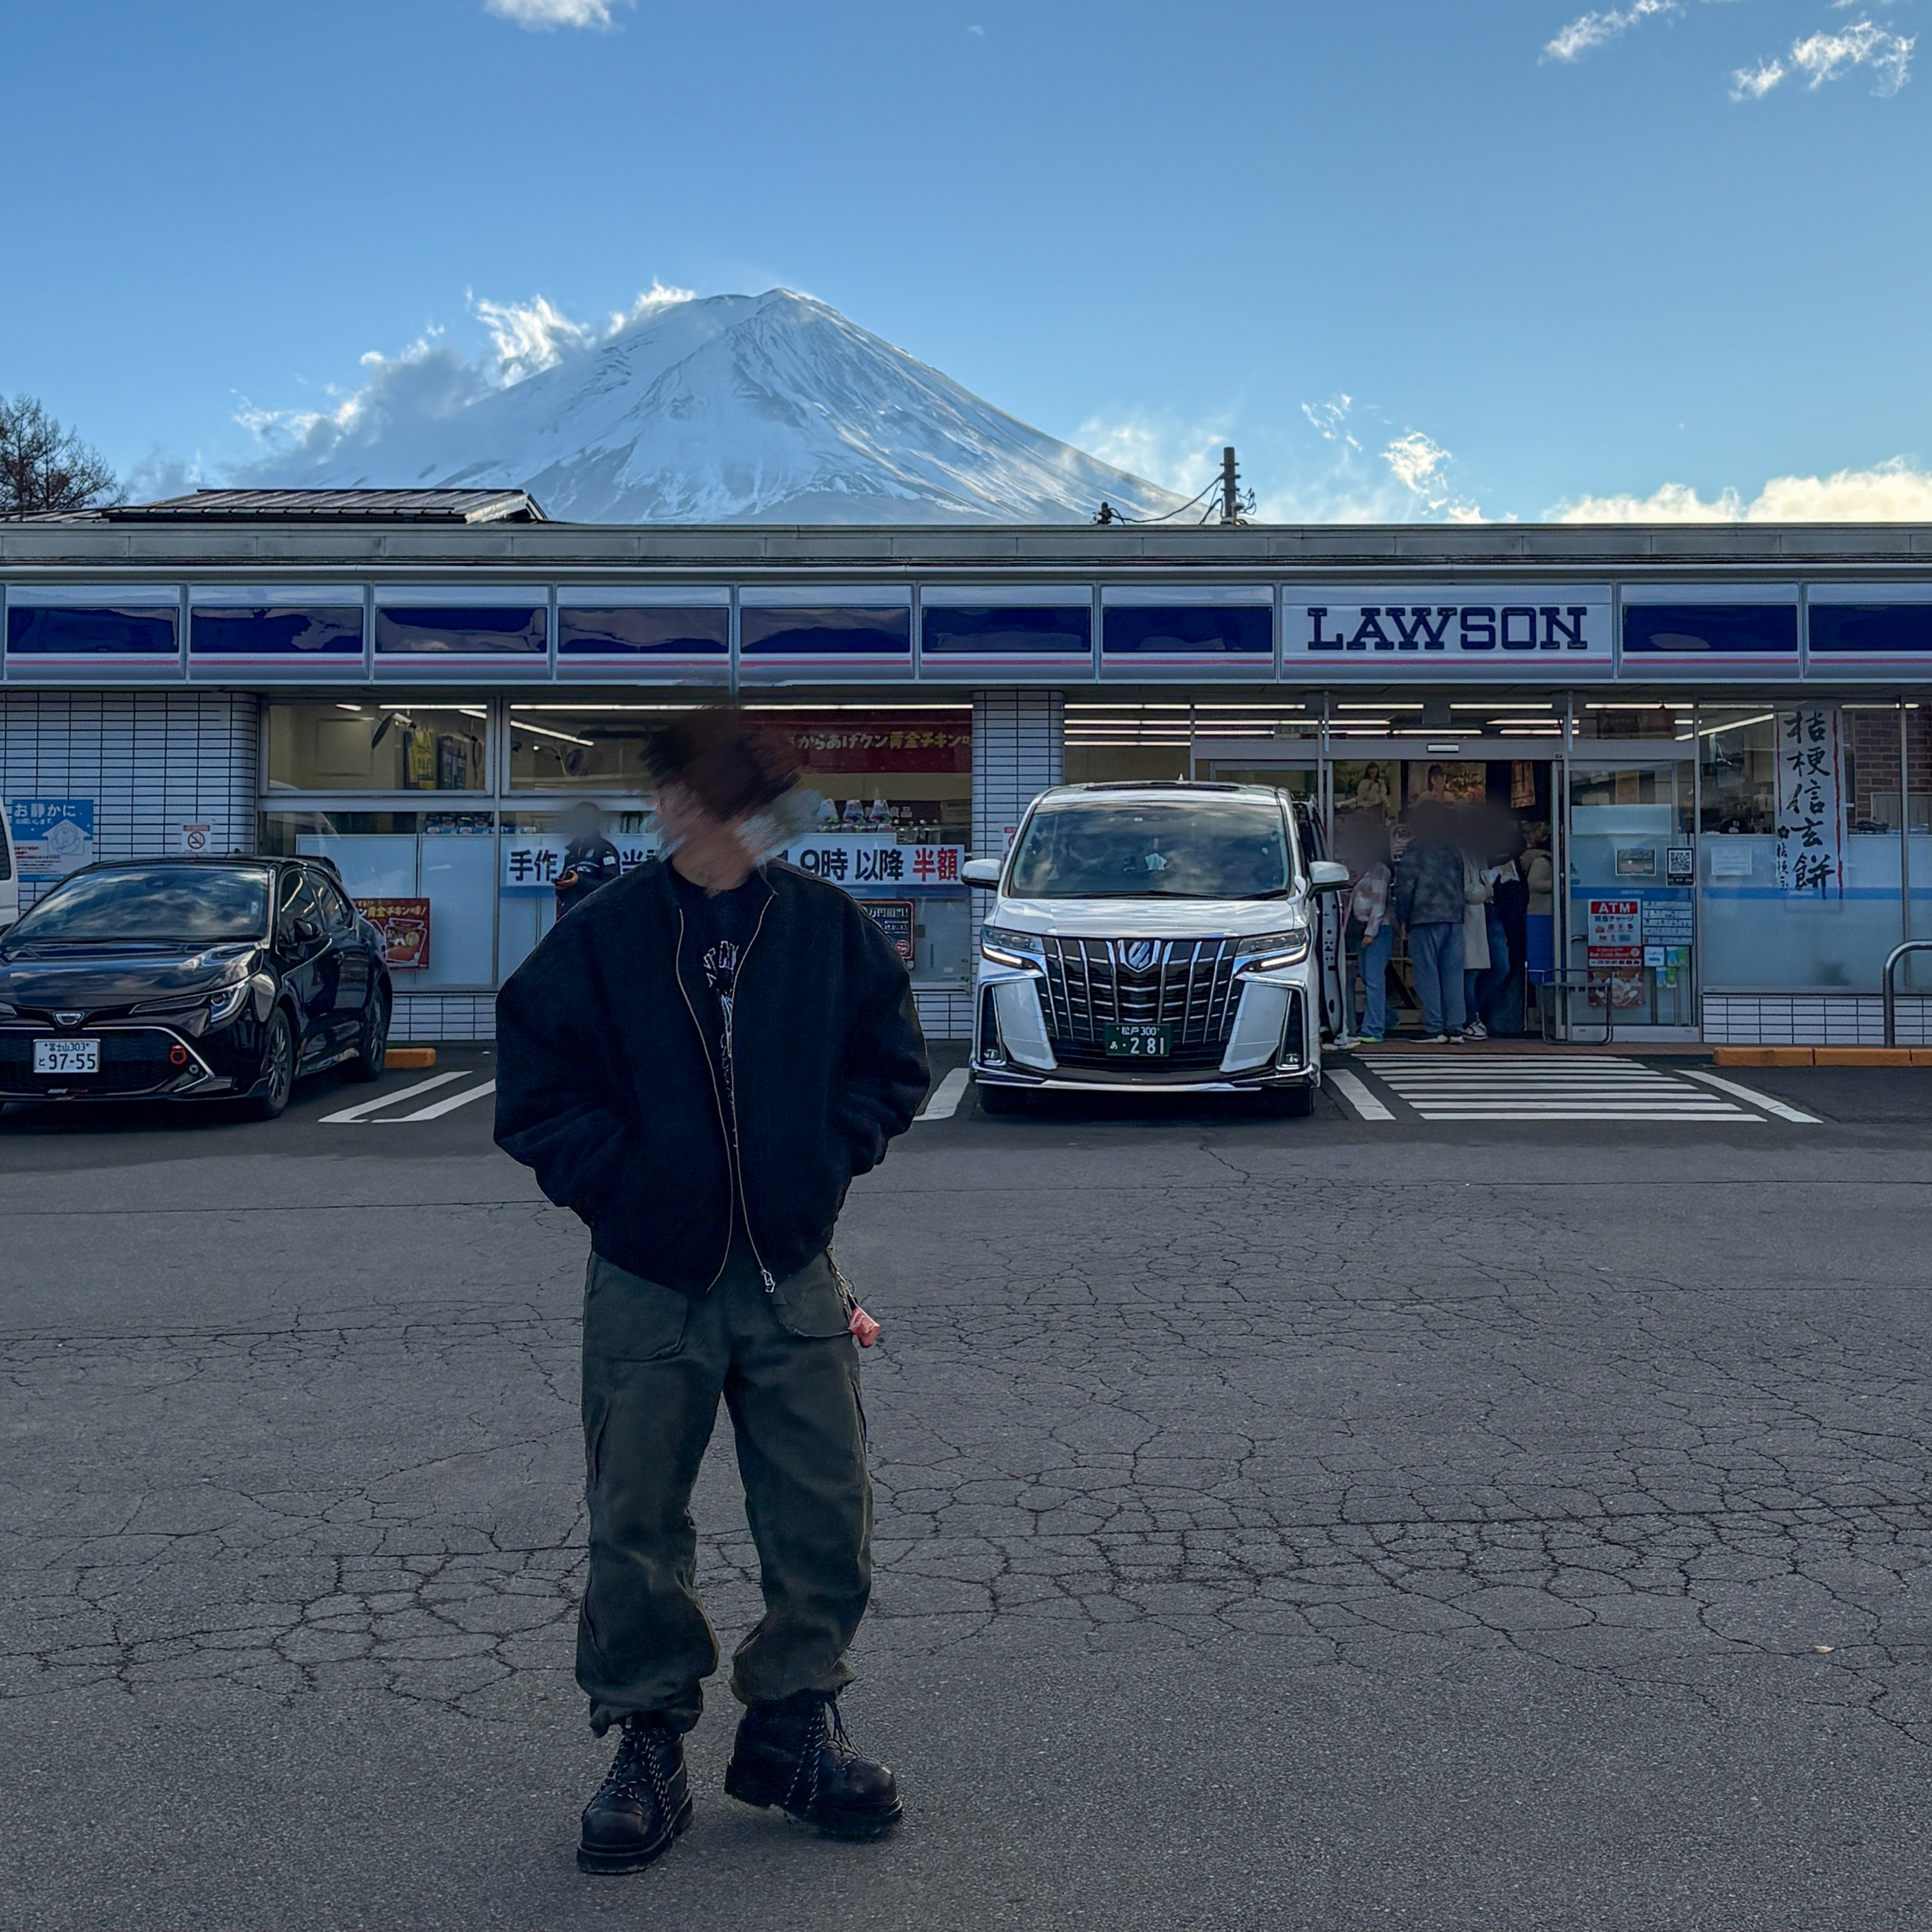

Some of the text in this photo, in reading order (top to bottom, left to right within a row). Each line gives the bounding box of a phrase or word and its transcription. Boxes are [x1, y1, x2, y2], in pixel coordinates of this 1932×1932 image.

[1308, 607, 1587, 650] LAWSON
[1598, 902, 1630, 913] ATM
[39, 1054, 96, 1070] と 97-55
